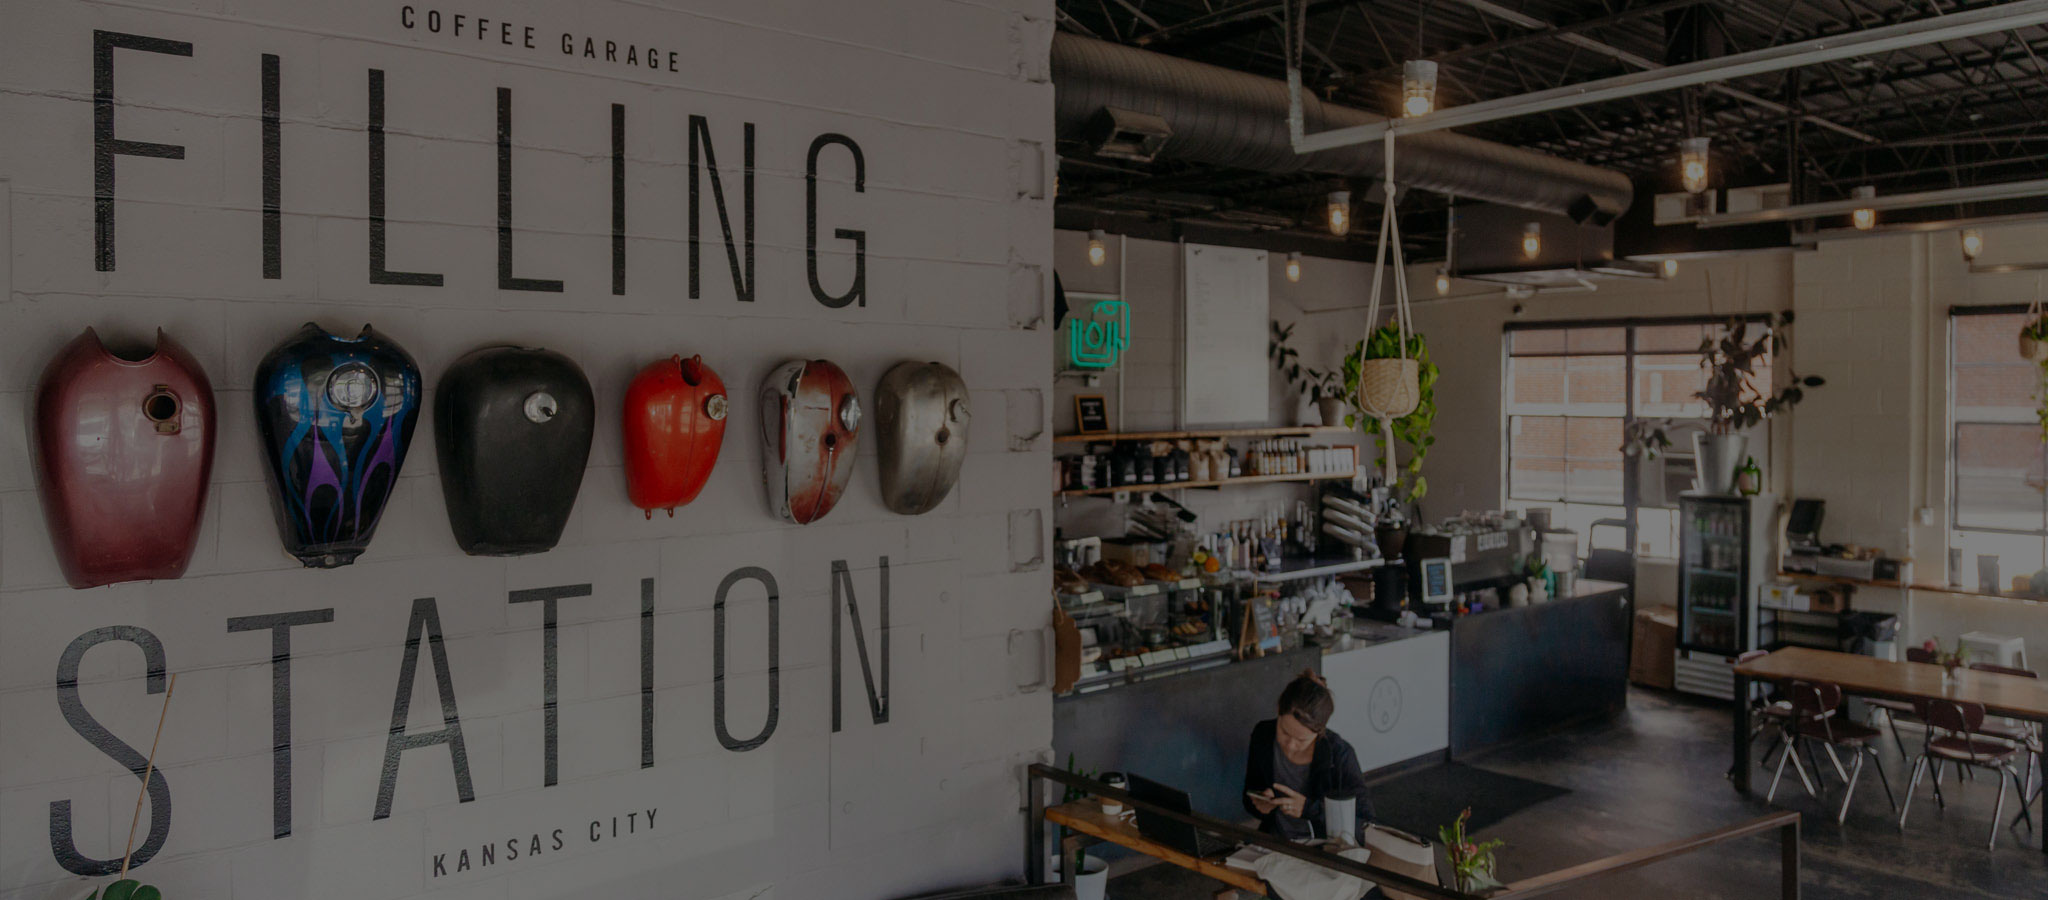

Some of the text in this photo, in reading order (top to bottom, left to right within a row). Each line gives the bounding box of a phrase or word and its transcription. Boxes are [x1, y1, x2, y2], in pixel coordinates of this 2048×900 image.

[401, 5, 680, 73] COFFEE GARAGE
[93, 30, 867, 309] FILLING
[49, 555, 890, 877] STATION
[433, 808, 657, 877] KANSAS CITY
